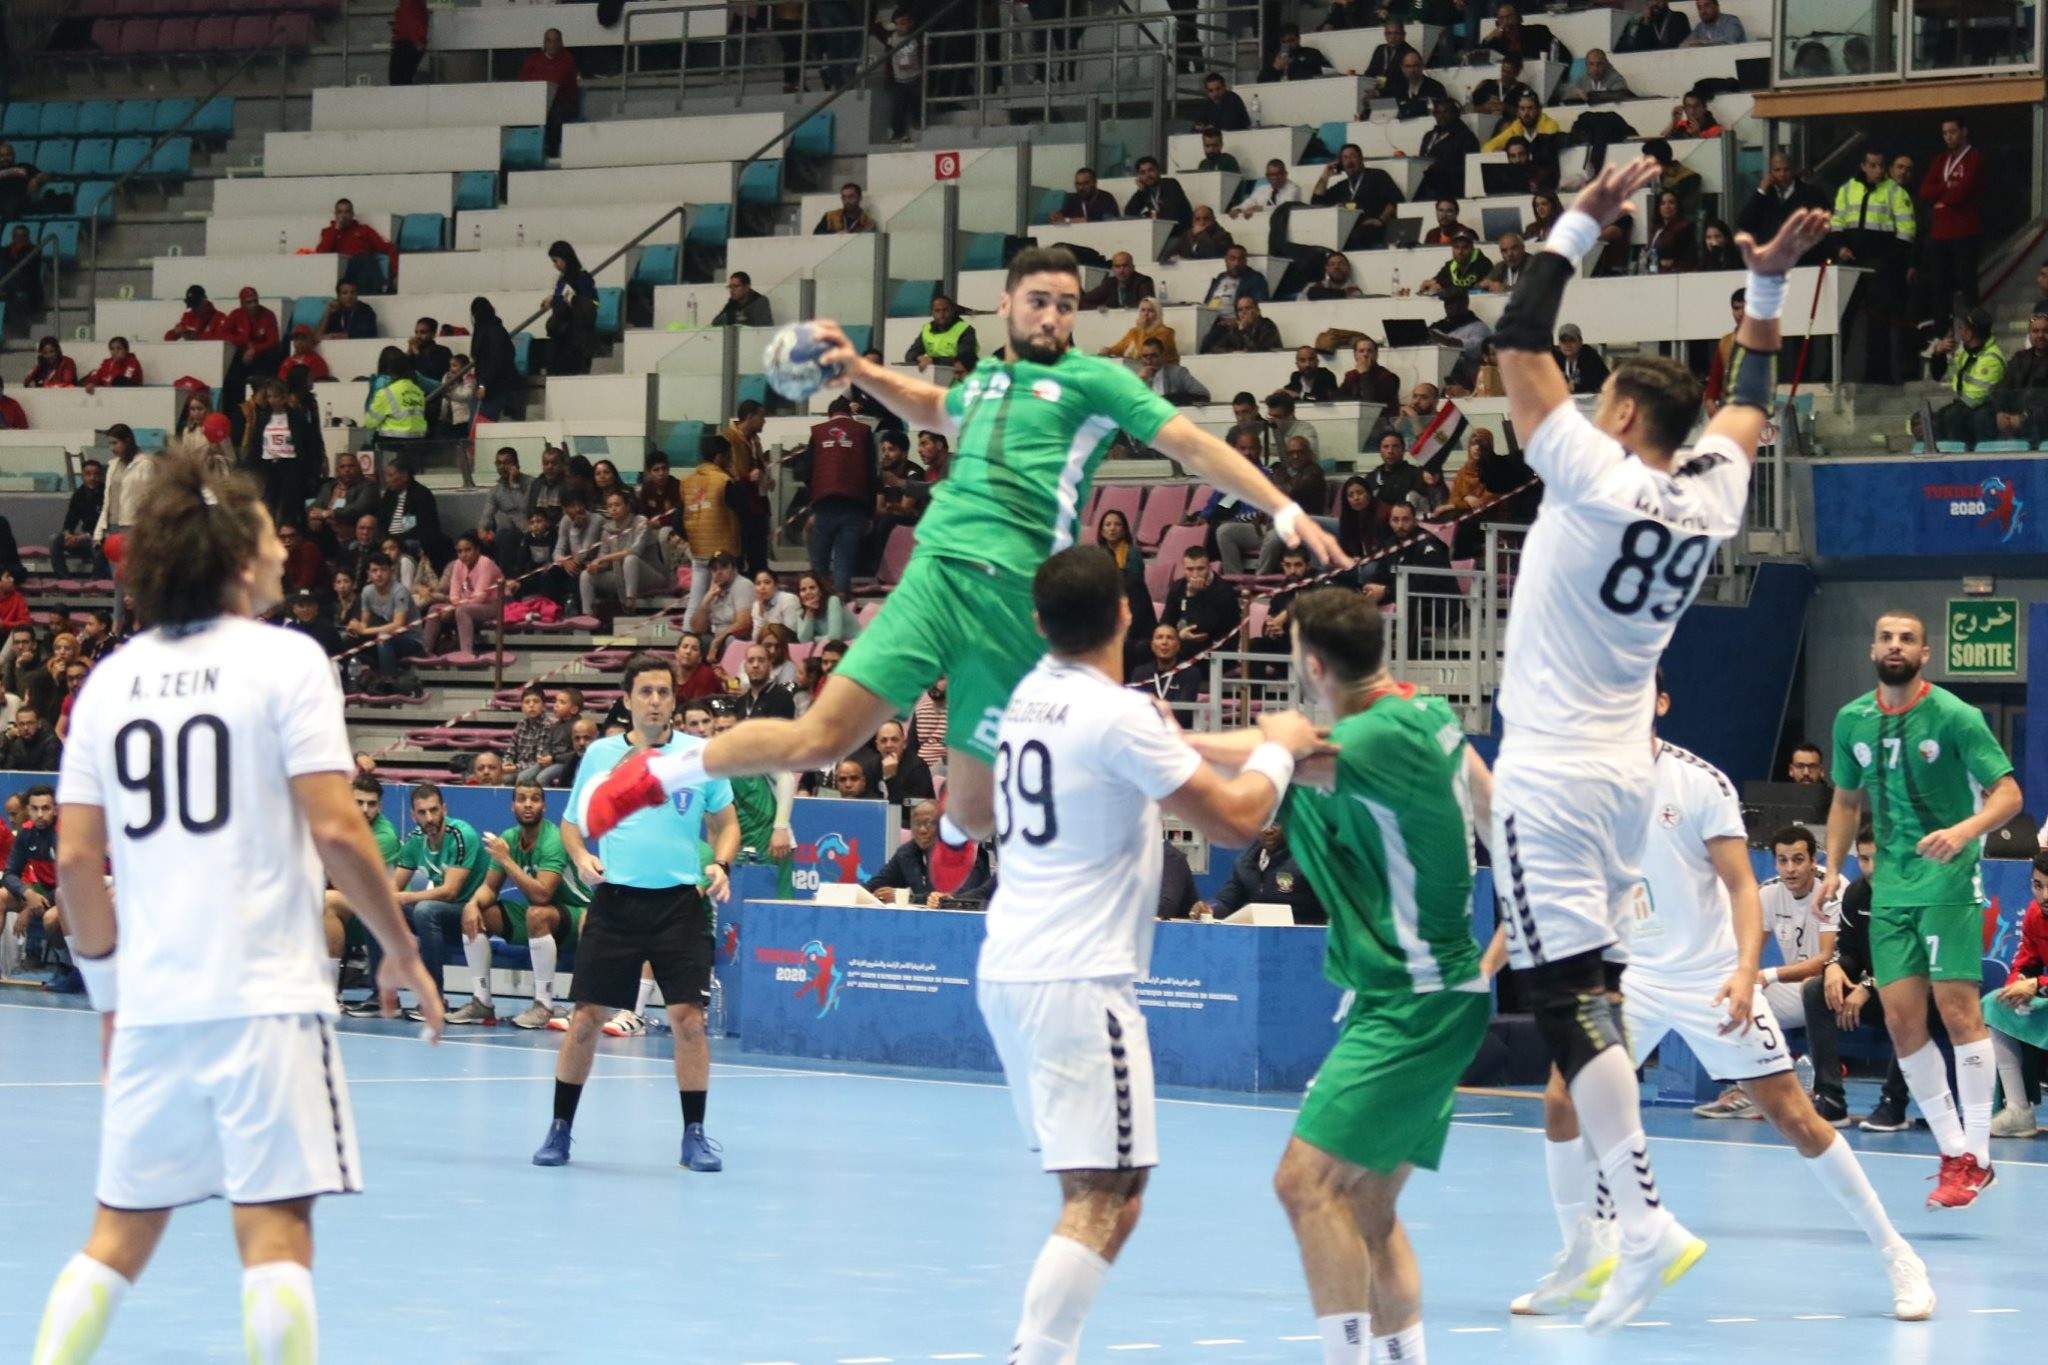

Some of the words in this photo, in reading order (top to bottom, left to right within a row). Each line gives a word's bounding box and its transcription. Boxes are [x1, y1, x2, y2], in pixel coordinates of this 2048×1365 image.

[1950, 502, 1986, 516] 2020
[1600, 519, 1710, 622] 89
[1952, 606, 2013, 642] خروج
[1951, 643, 2013, 668] SORTIE
[159, 666, 220, 698] ZEIN
[1882, 738, 1902, 769] 7
[114, 713, 231, 841] 90
[1795, 926, 1804, 948] 2
[1926, 935, 1940, 966] 7
[775, 966, 808, 982] 2020
[1753, 1014, 1777, 1051] 5
